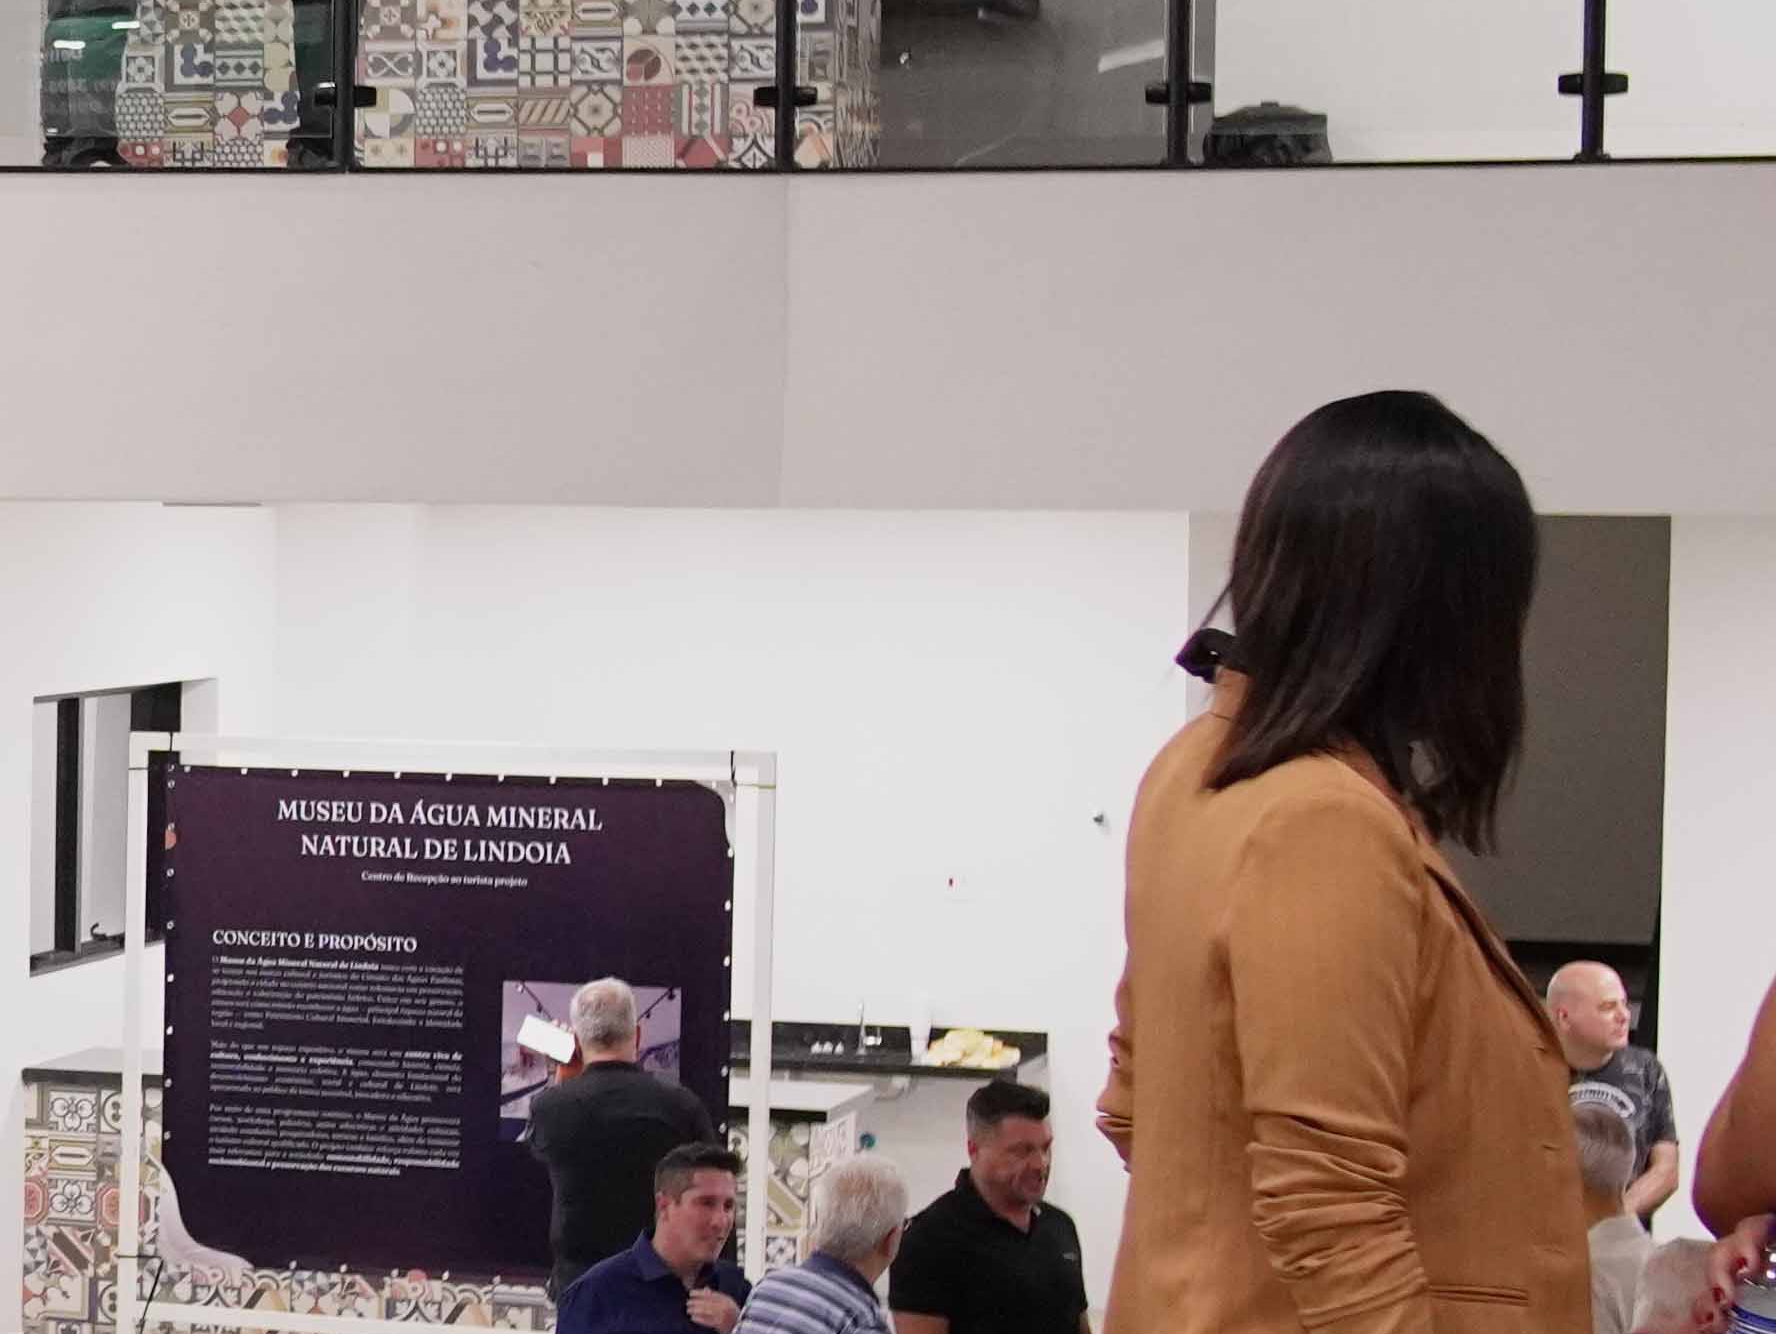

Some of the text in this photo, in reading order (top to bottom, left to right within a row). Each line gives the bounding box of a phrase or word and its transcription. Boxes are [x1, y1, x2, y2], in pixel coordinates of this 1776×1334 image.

[277, 799, 603, 831] MUSEU DA ÁGUA MINERAL
[300, 834, 571, 865] NATURAL DE LINDOIA
[361, 870, 392, 882] Centro
[393, 872, 405, 883] de
[406, 872, 449, 885] Recepção
[463, 874, 493, 886] turista
[494, 876, 528, 888] projeto
[212, 929, 418, 953] CONCEITO E PROPÓSITO
